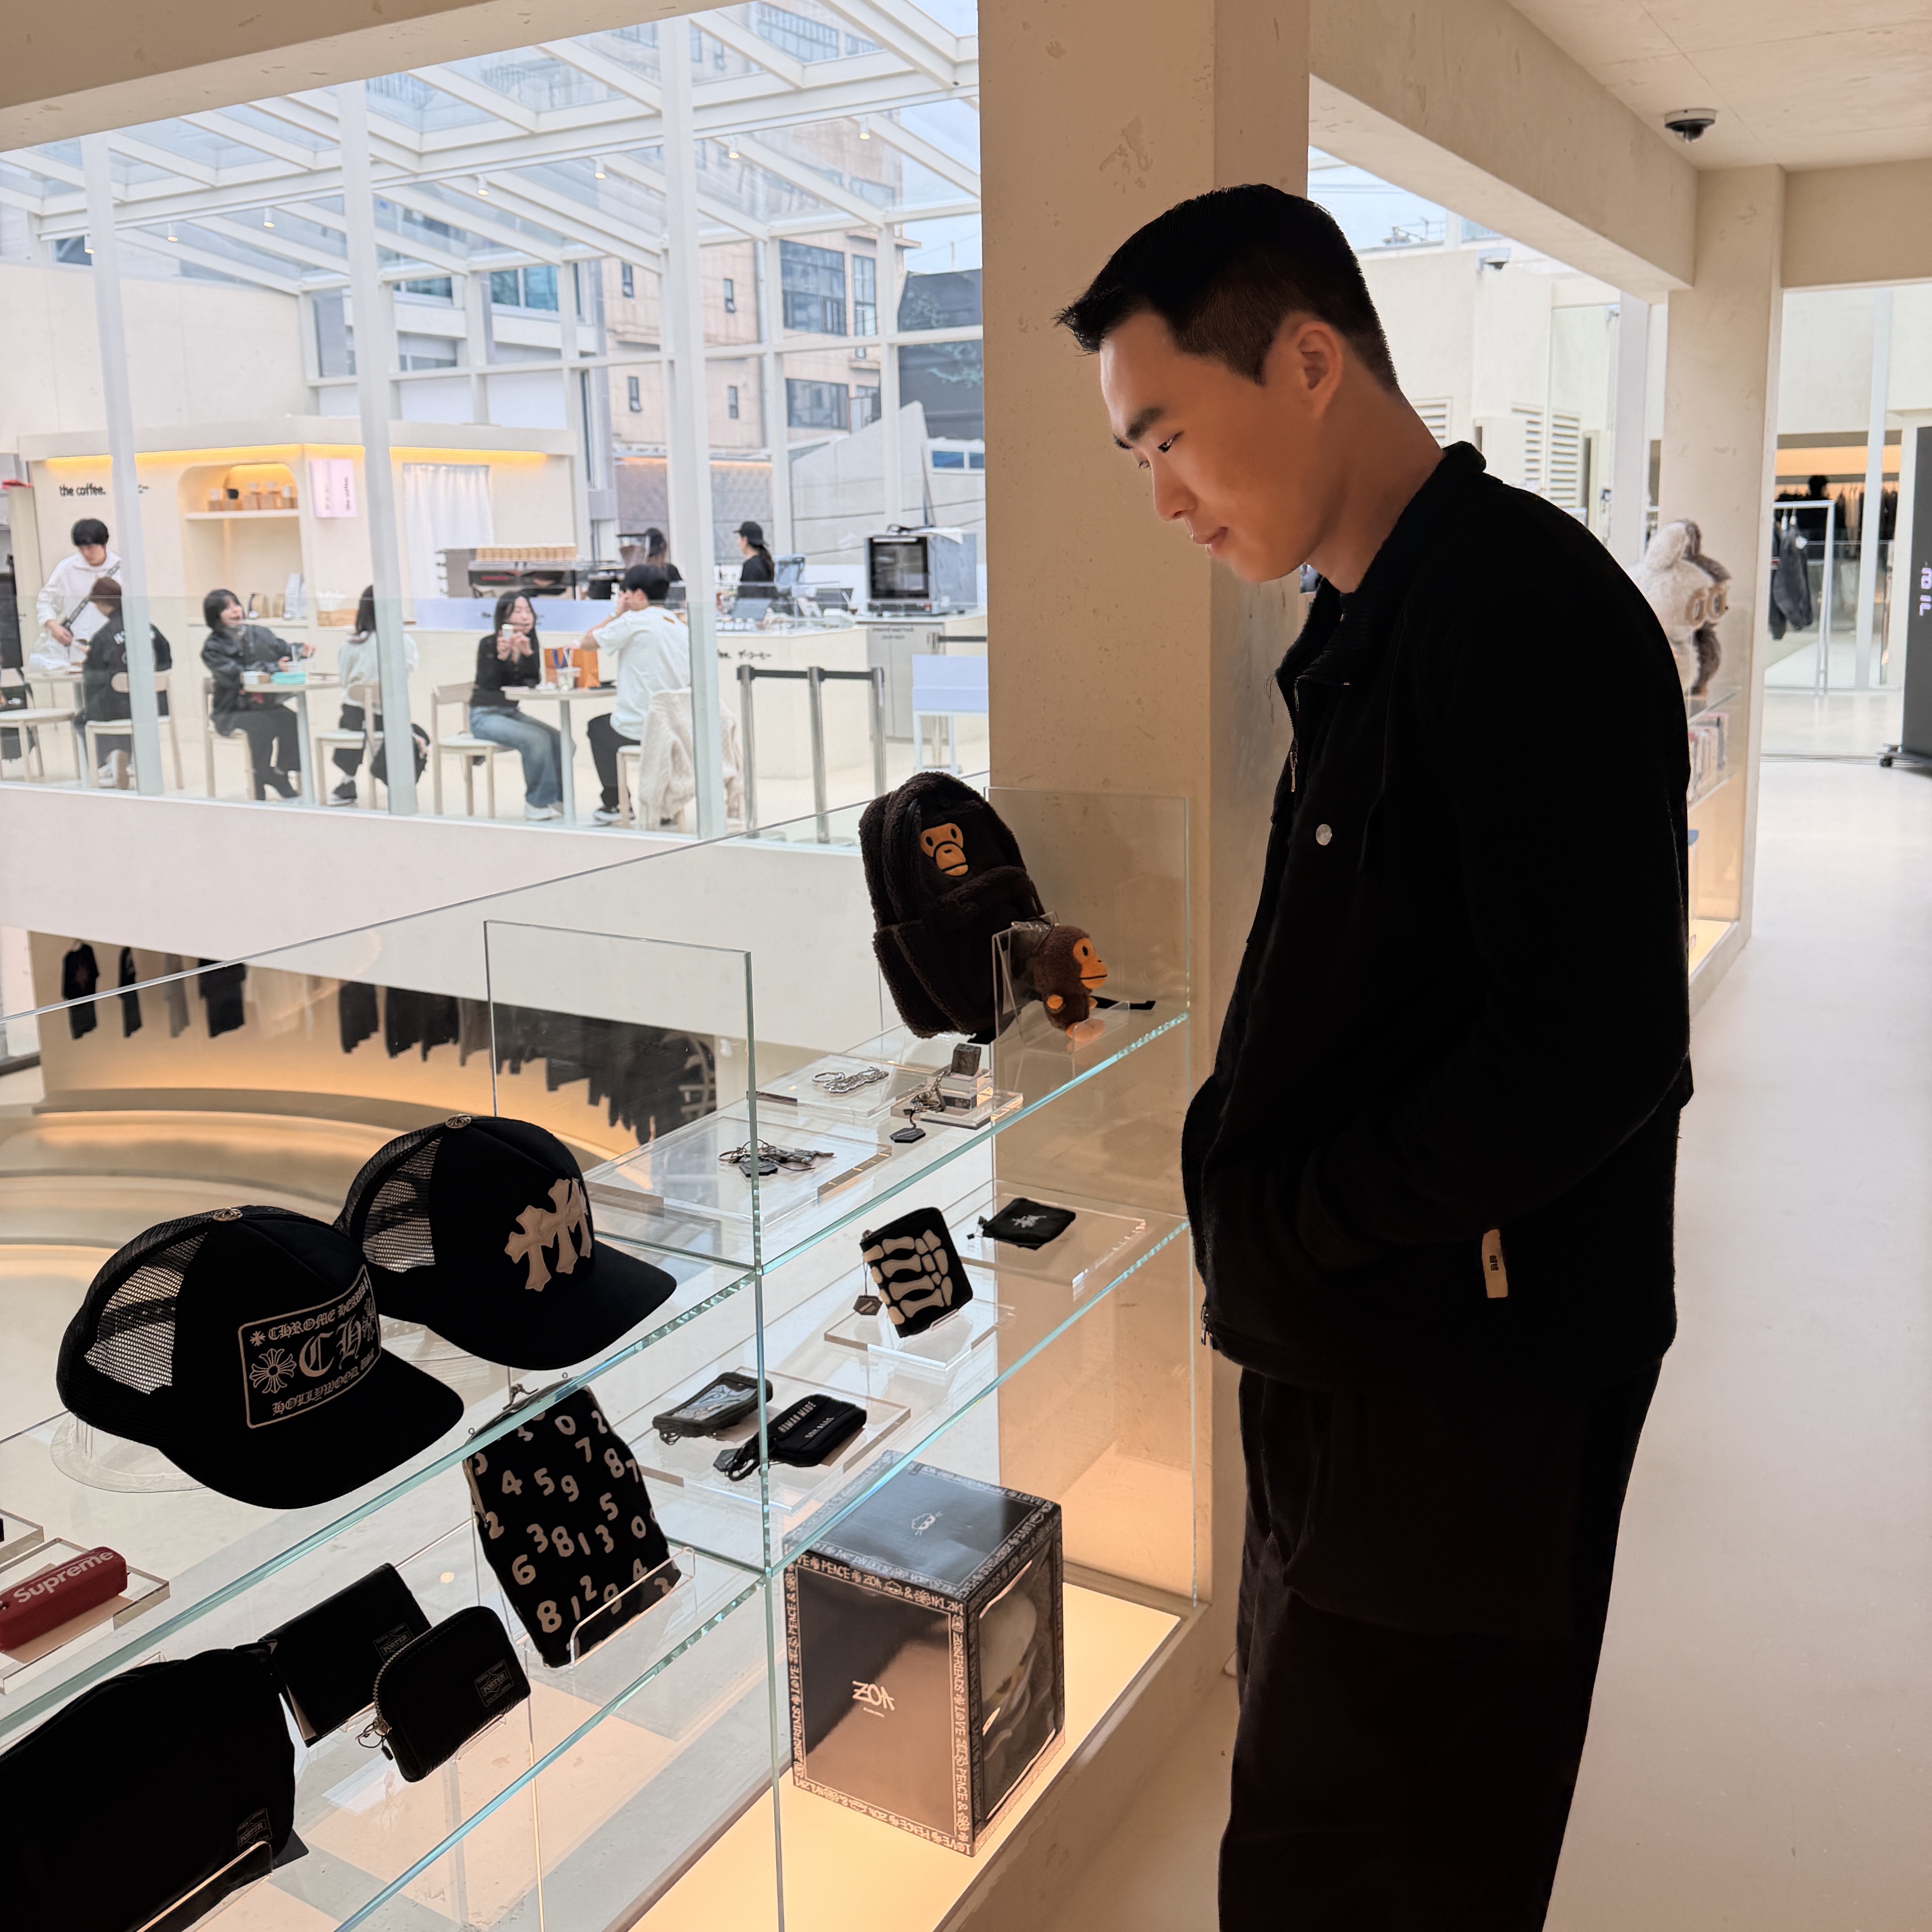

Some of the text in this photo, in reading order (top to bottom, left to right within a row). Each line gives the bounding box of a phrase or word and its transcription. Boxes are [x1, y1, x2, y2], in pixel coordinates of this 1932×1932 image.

[59, 483, 74, 497] the
[268, 1309, 336, 1341] CHROME
[554, 1415, 576, 1435] 0
[777, 1413, 802, 1434] HUMAN
[796, 1401, 817, 1417] MADE
[575, 1437, 591, 1462] 7
[604, 1448, 625, 1478] 8
[502, 1470, 522, 1495] 4
[534, 1468, 554, 1495] 5
[561, 1475, 579, 1502] 9
[600, 1492, 618, 1520] 5
[485, 1511, 504, 1539] 2
[526, 1523, 548, 1553] 3
[595, 1524, 614, 1553] 3
[631, 1516, 646, 1538] 0
[551, 1526, 574, 1557] 8
[13, 1551, 114, 1604] Supreme
[512, 1554, 536, 1585] 6
[580, 1575, 597, 1601] 2
[537, 1600, 562, 1633] 8
[383, 1634, 408, 1653] PORTER
[483, 1673, 506, 1694] PORTER
[240, 1822, 264, 1844] PORTER
